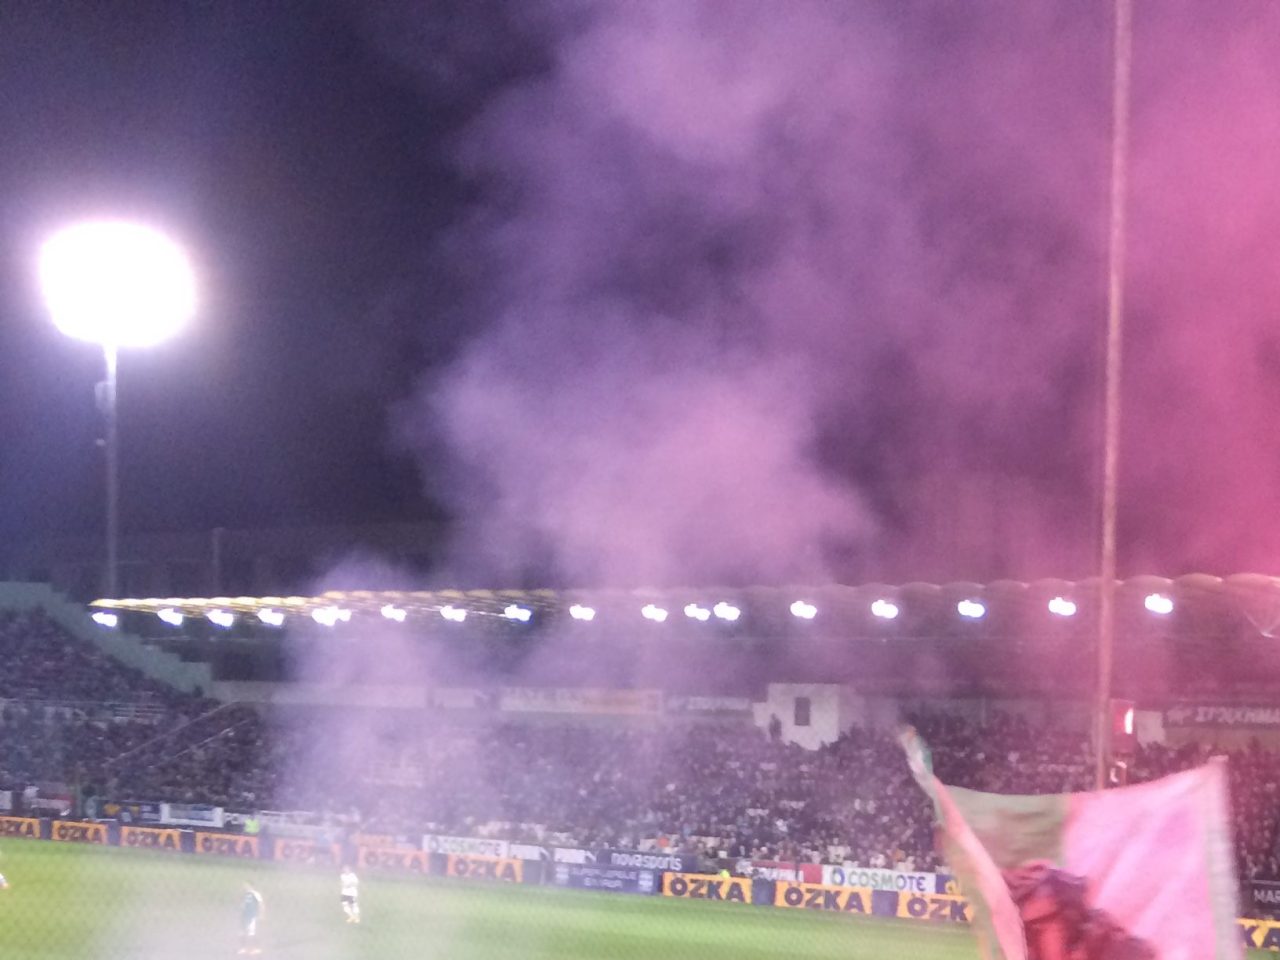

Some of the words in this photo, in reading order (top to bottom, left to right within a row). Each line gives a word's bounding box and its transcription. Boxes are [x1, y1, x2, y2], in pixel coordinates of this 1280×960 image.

[611, 852, 682, 871] novasports
[849, 871, 926, 892] COSMOTE
[907, 893, 969, 922] ÖZK
